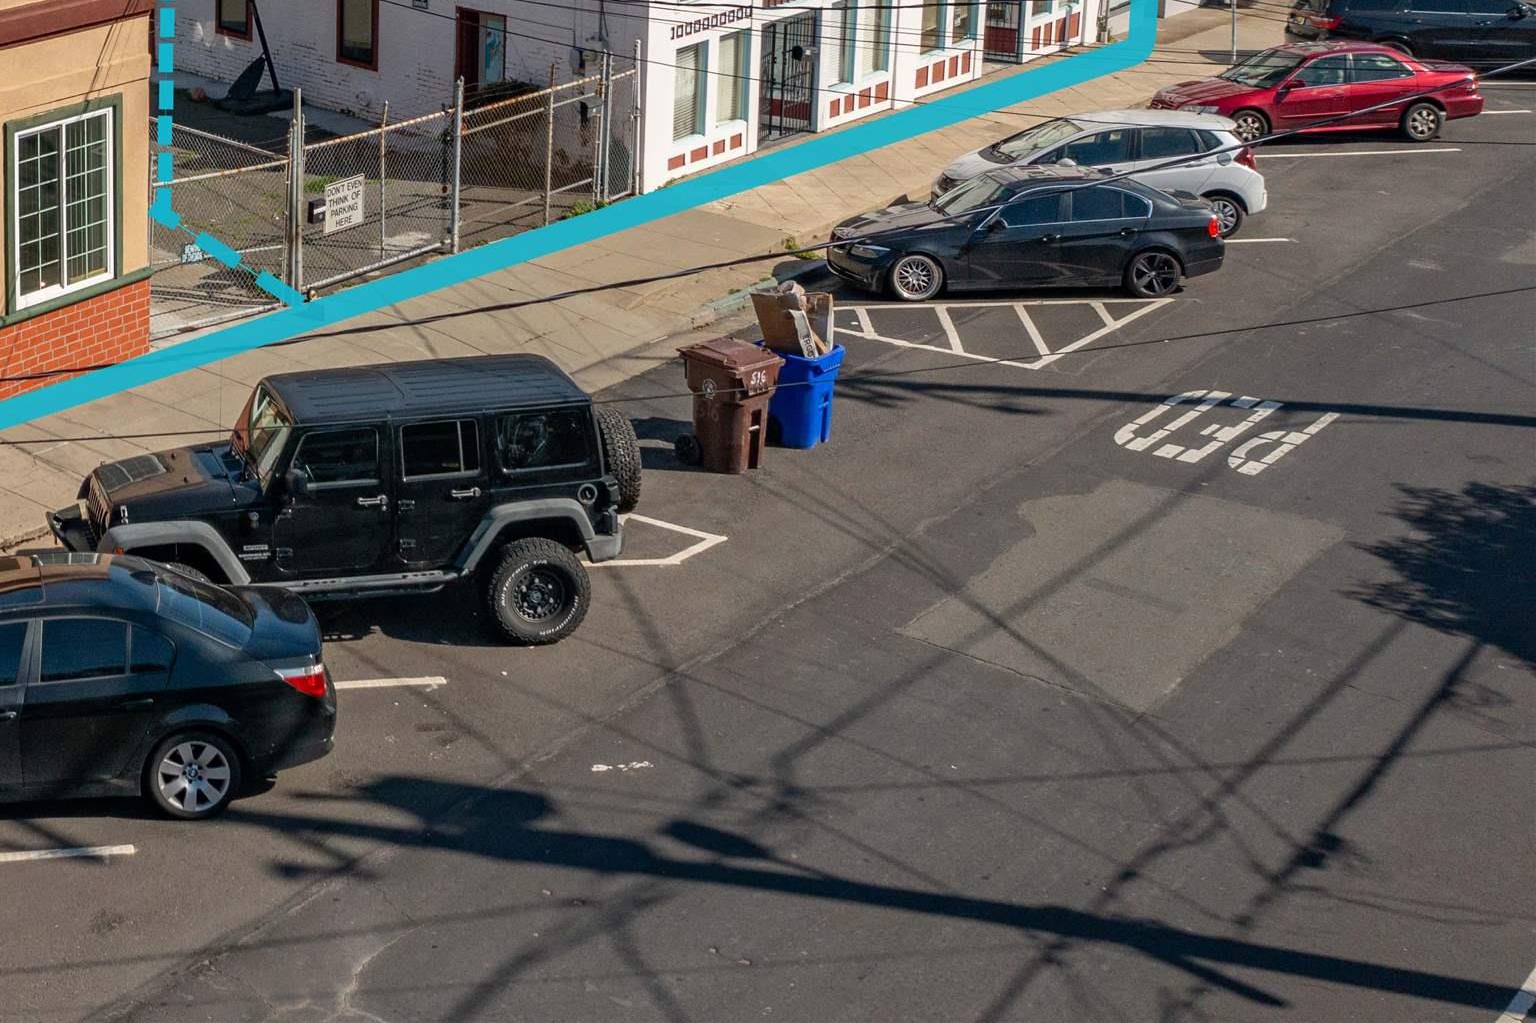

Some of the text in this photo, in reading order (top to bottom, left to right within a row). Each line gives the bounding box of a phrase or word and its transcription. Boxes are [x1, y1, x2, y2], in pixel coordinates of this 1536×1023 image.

[327, 179, 362, 197] DON'T EVEN
[328, 189, 361, 208] THINK OF
[330, 202, 358, 218] PARKING
[335, 216, 353, 228] HERE
[1114, 389, 1341, 476] PED
